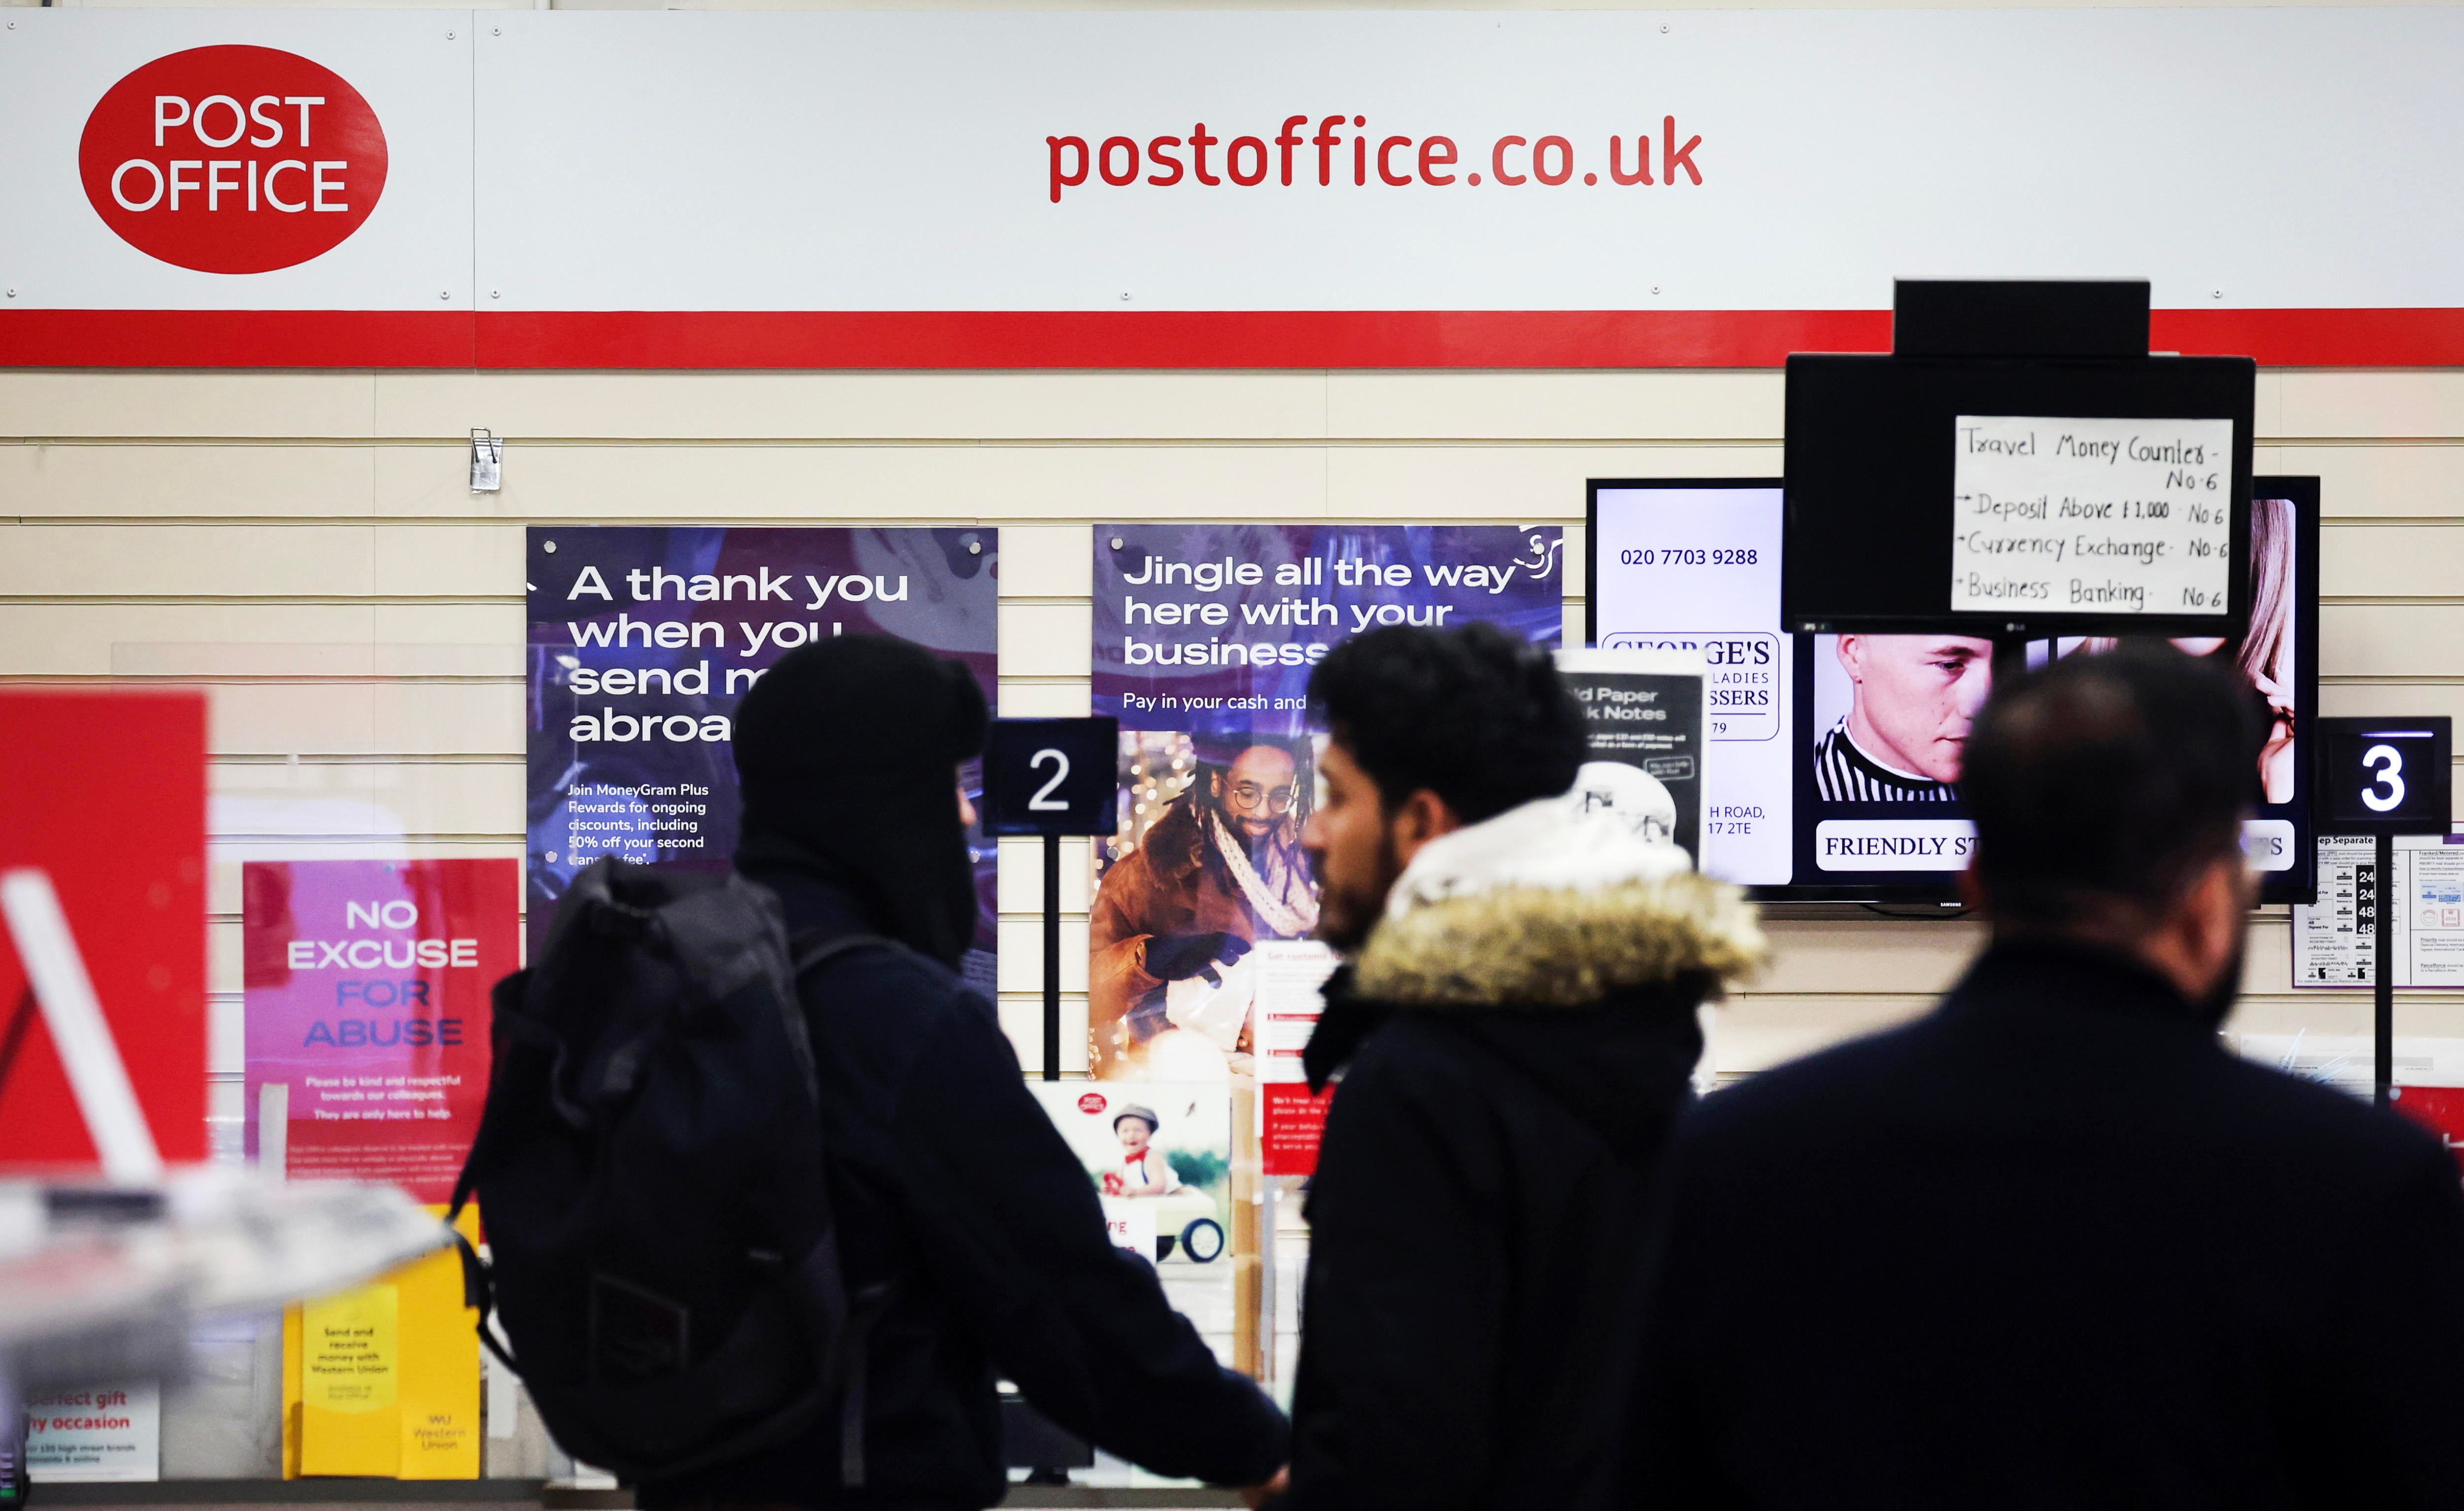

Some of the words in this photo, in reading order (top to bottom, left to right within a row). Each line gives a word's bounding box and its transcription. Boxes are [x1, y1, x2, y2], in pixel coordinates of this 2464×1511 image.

[155, 94, 325, 148] POST
[1046, 115, 1703, 203] postoffice.co.uk
[111, 159, 348, 213] OFFICE
[1960, 427, 2035, 456] Travel
[2056, 435, 2120, 465] Money
[2128, 436, 2204, 465] Counter
[1972, 493, 2048, 521] Deposit
[2059, 497, 2113, 519] Above
[1969, 531, 2066, 562] Currency
[1621, 550, 1655, 565] 020
[1661, 550, 1706, 565] 7703
[1712, 549, 1757, 565] 9288
[1123, 556, 1263, 591] Jingle
[1275, 557, 1321, 586] all
[1334, 558, 1412, 586] the
[1422, 565, 1516, 594] way
[567, 566, 614, 601] A
[626, 566, 793, 602] thank
[805, 576, 908, 610] you
[1969, 572, 2052, 599] Business
[2070, 579, 2145, 611] Banking
[1125, 596, 1228, 626] here
[1240, 597, 1338, 626] with
[1350, 604, 1453, 633] your
[567, 613, 725, 648] when
[739, 623, 842, 657] you
[1612, 641, 1770, 665] GE'S
[569, 660, 709, 695] send
[1712, 673, 1769, 684] LADIES
[1124, 693, 1157, 712] Pay
[1162, 693, 1177, 709] in
[1183, 696, 1223, 712] your
[1228, 694, 1268, 709] cash
[1274, 695, 1307, 709] and
[1597, 688, 1658, 705] Paper
[1604, 706, 1667, 721] Notes
[569, 707, 731, 742] abroa
[1028, 748, 1070, 810] 2
[2361, 744, 2405, 811] 3
[568, 784, 593, 796] Join
[597, 784, 676, 798] MoneyGram
[681, 784, 709, 796] Plus
[569, 801, 625, 813] Rewards
[629, 801, 649, 813] for
[651, 802, 706, 815] ongoing
[1725, 806, 1765, 820] ROAD,
[568, 819, 634, 832] discounts,
[638, 819, 698, 833] including
[1728, 823, 1751, 834] 2TE
[569, 836, 598, 848] 50%
[602, 836, 621, 848] off
[624, 839, 654, 850] your
[657, 837, 704, 848] second
[1825, 838, 1948, 855] FRIENDLY
[2333, 837, 2373, 845] Separate
[2359, 872, 2375, 882] 24
[2359, 889, 2375, 900] 24
[346, 900, 418, 930] NO
[2359, 907, 2375, 917] 48
[2359, 924, 2375, 934] 48
[288, 939, 479, 970] EXCUSE
[336, 979, 430, 1008] FOR
[303, 1018, 463, 1048] ABUSE
[306, 1076, 341, 1087] Please
[342, 1077, 356, 1086] be
[385, 1076, 405, 1086] and
[407, 1075, 461, 1087] respectful
[320, 1091, 365, 1101] towards
[315, 1109, 340, 1120] They
[342, 1111, 360, 1120] are
[362, 1110, 385, 1121] only
[387, 1109, 411, 1119] here
[413, 1109, 425, 1119] to
[325, 1327, 350, 1337] Send
[353, 1328, 374, 1337] and
[317, 1354, 354, 1363] money
[311, 1365, 354, 1374] Western
[357, 1365, 389, 1375] Union
[96, 1390, 128, 1410] gift
[52, 1413, 130, 1430] occasion
